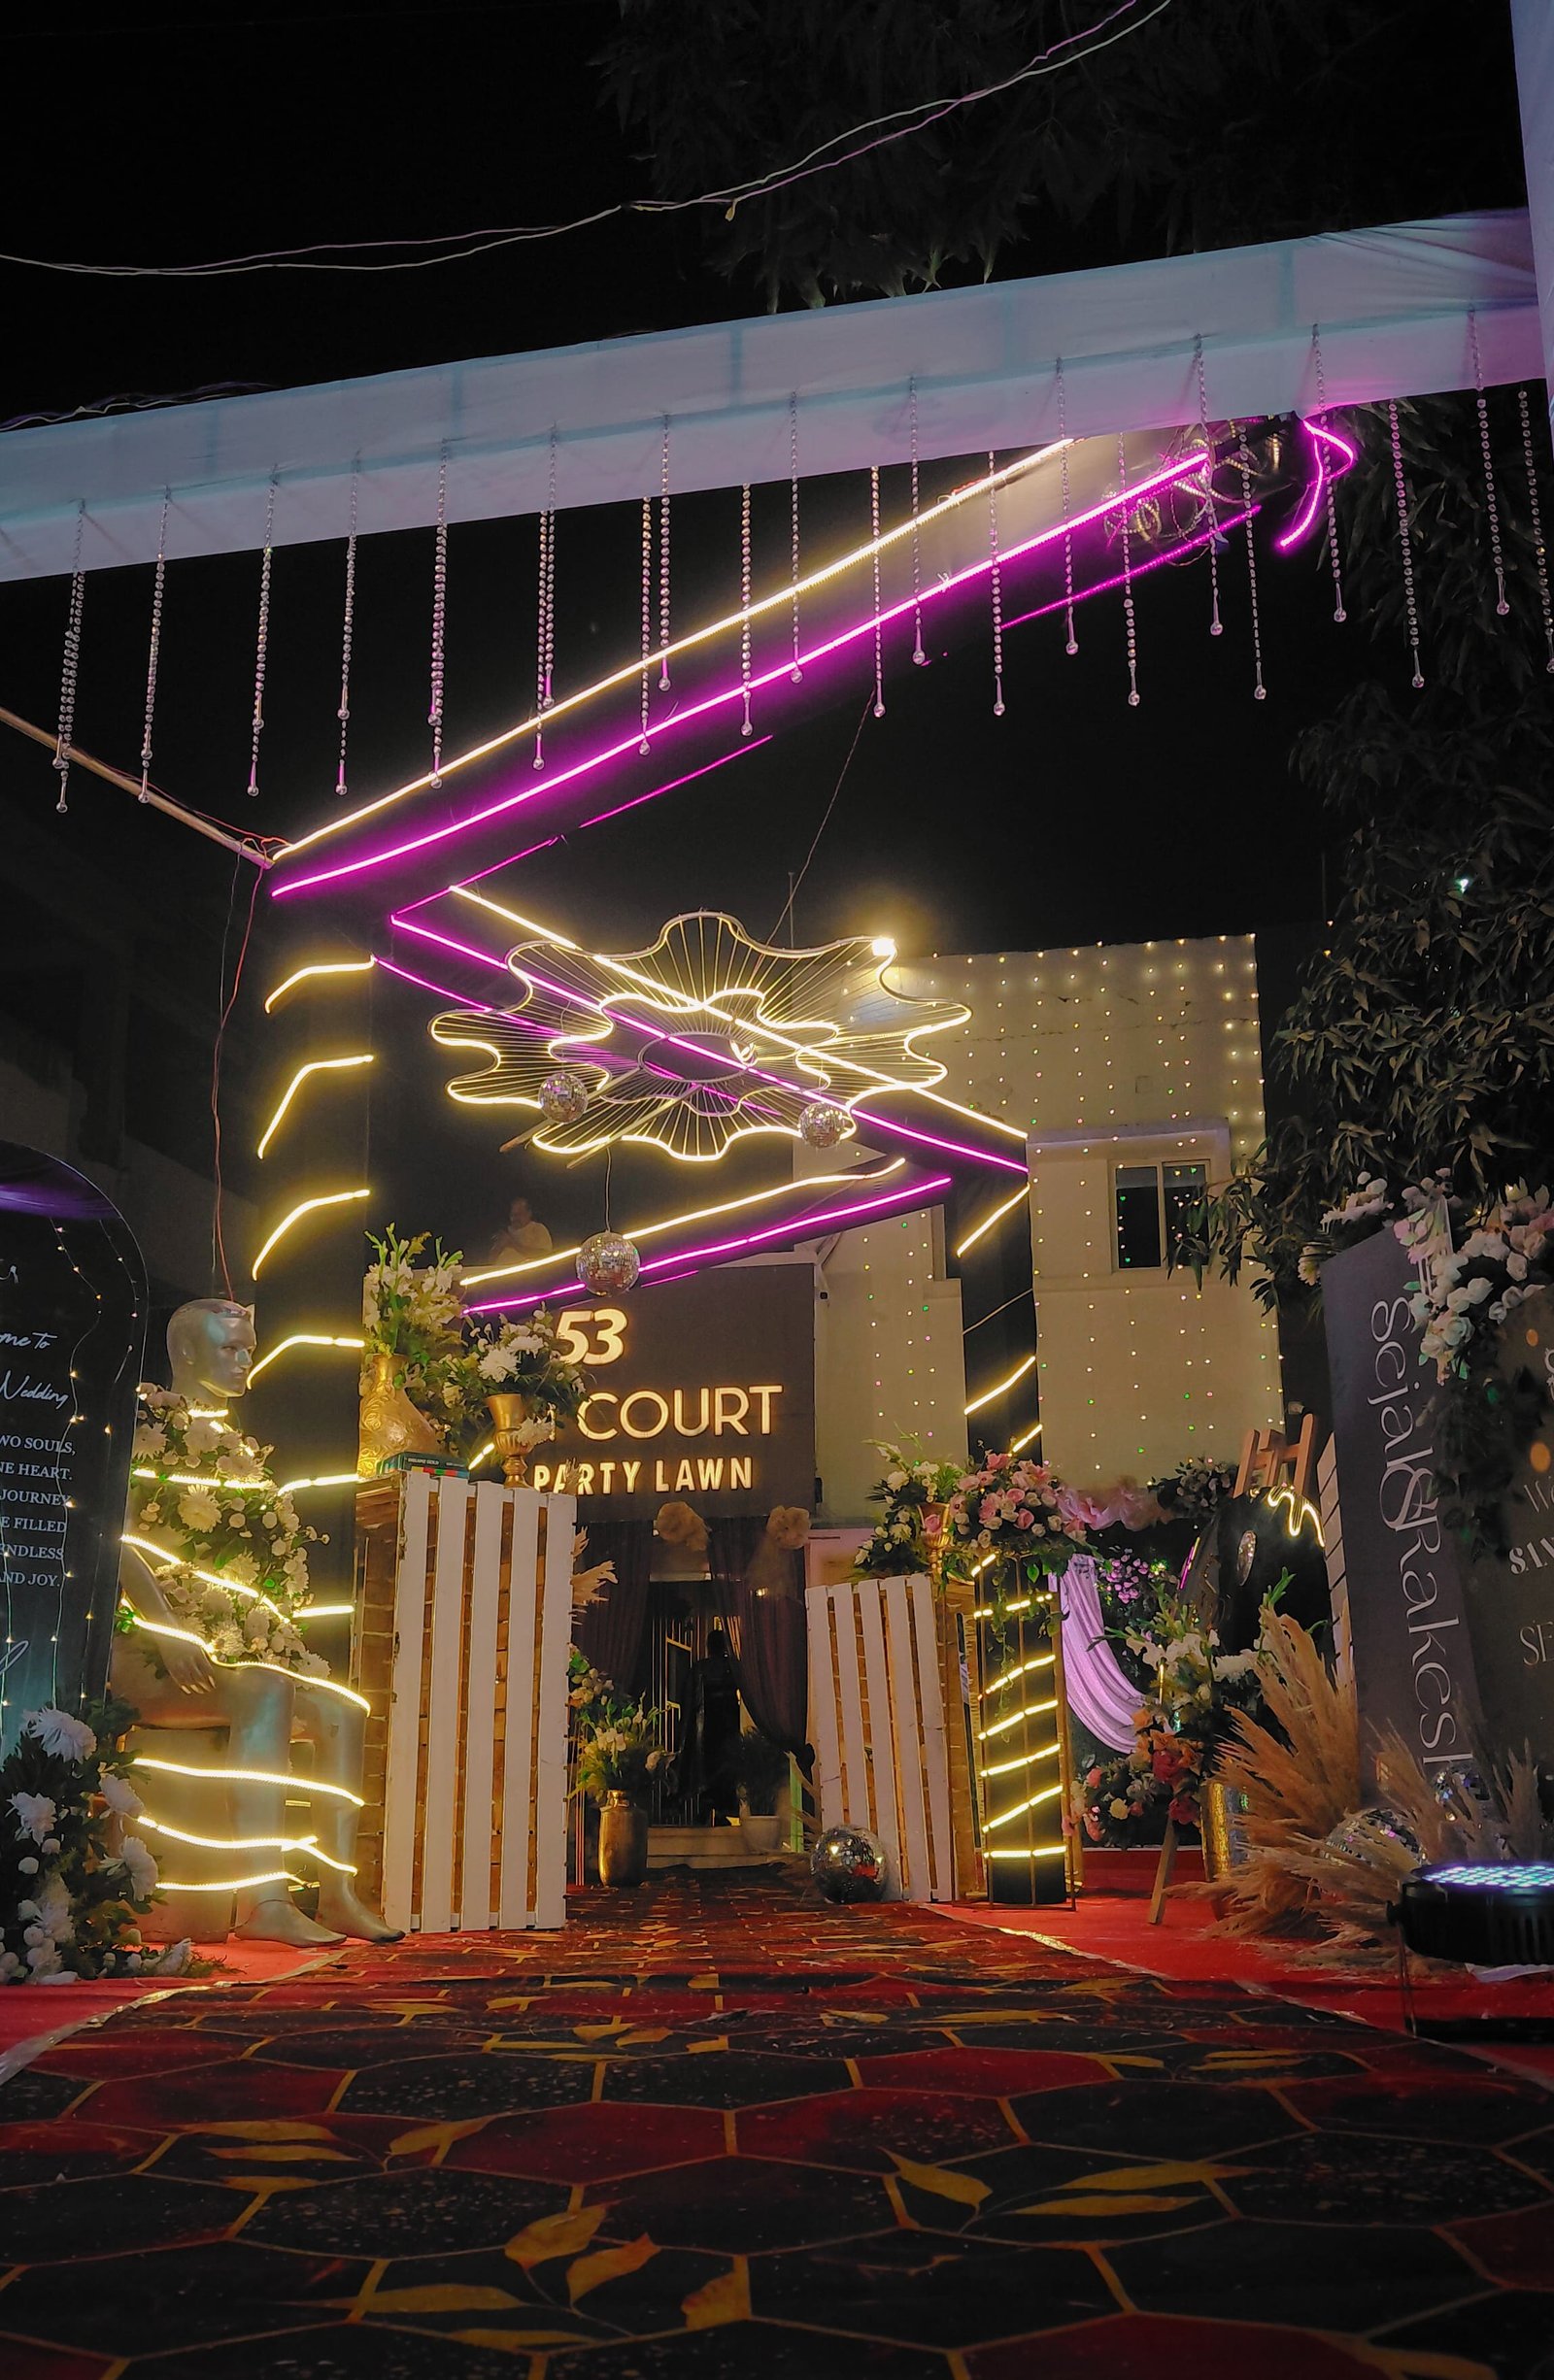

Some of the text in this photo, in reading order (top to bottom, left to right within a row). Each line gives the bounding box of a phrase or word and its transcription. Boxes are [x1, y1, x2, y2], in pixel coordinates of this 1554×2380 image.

[32, 1332, 57, 1349] To
[557, 1308, 627, 1365] 53
[577, 1385, 783, 1441] COURT
[23, 1437, 76, 1456] SOULS,
[17, 1463, 73, 1481] HEART.
[534, 1457, 752, 1495] PARTY LAWN
[14, 1517, 67, 1533] FILLED
[27, 1573, 60, 1587] JOY.
